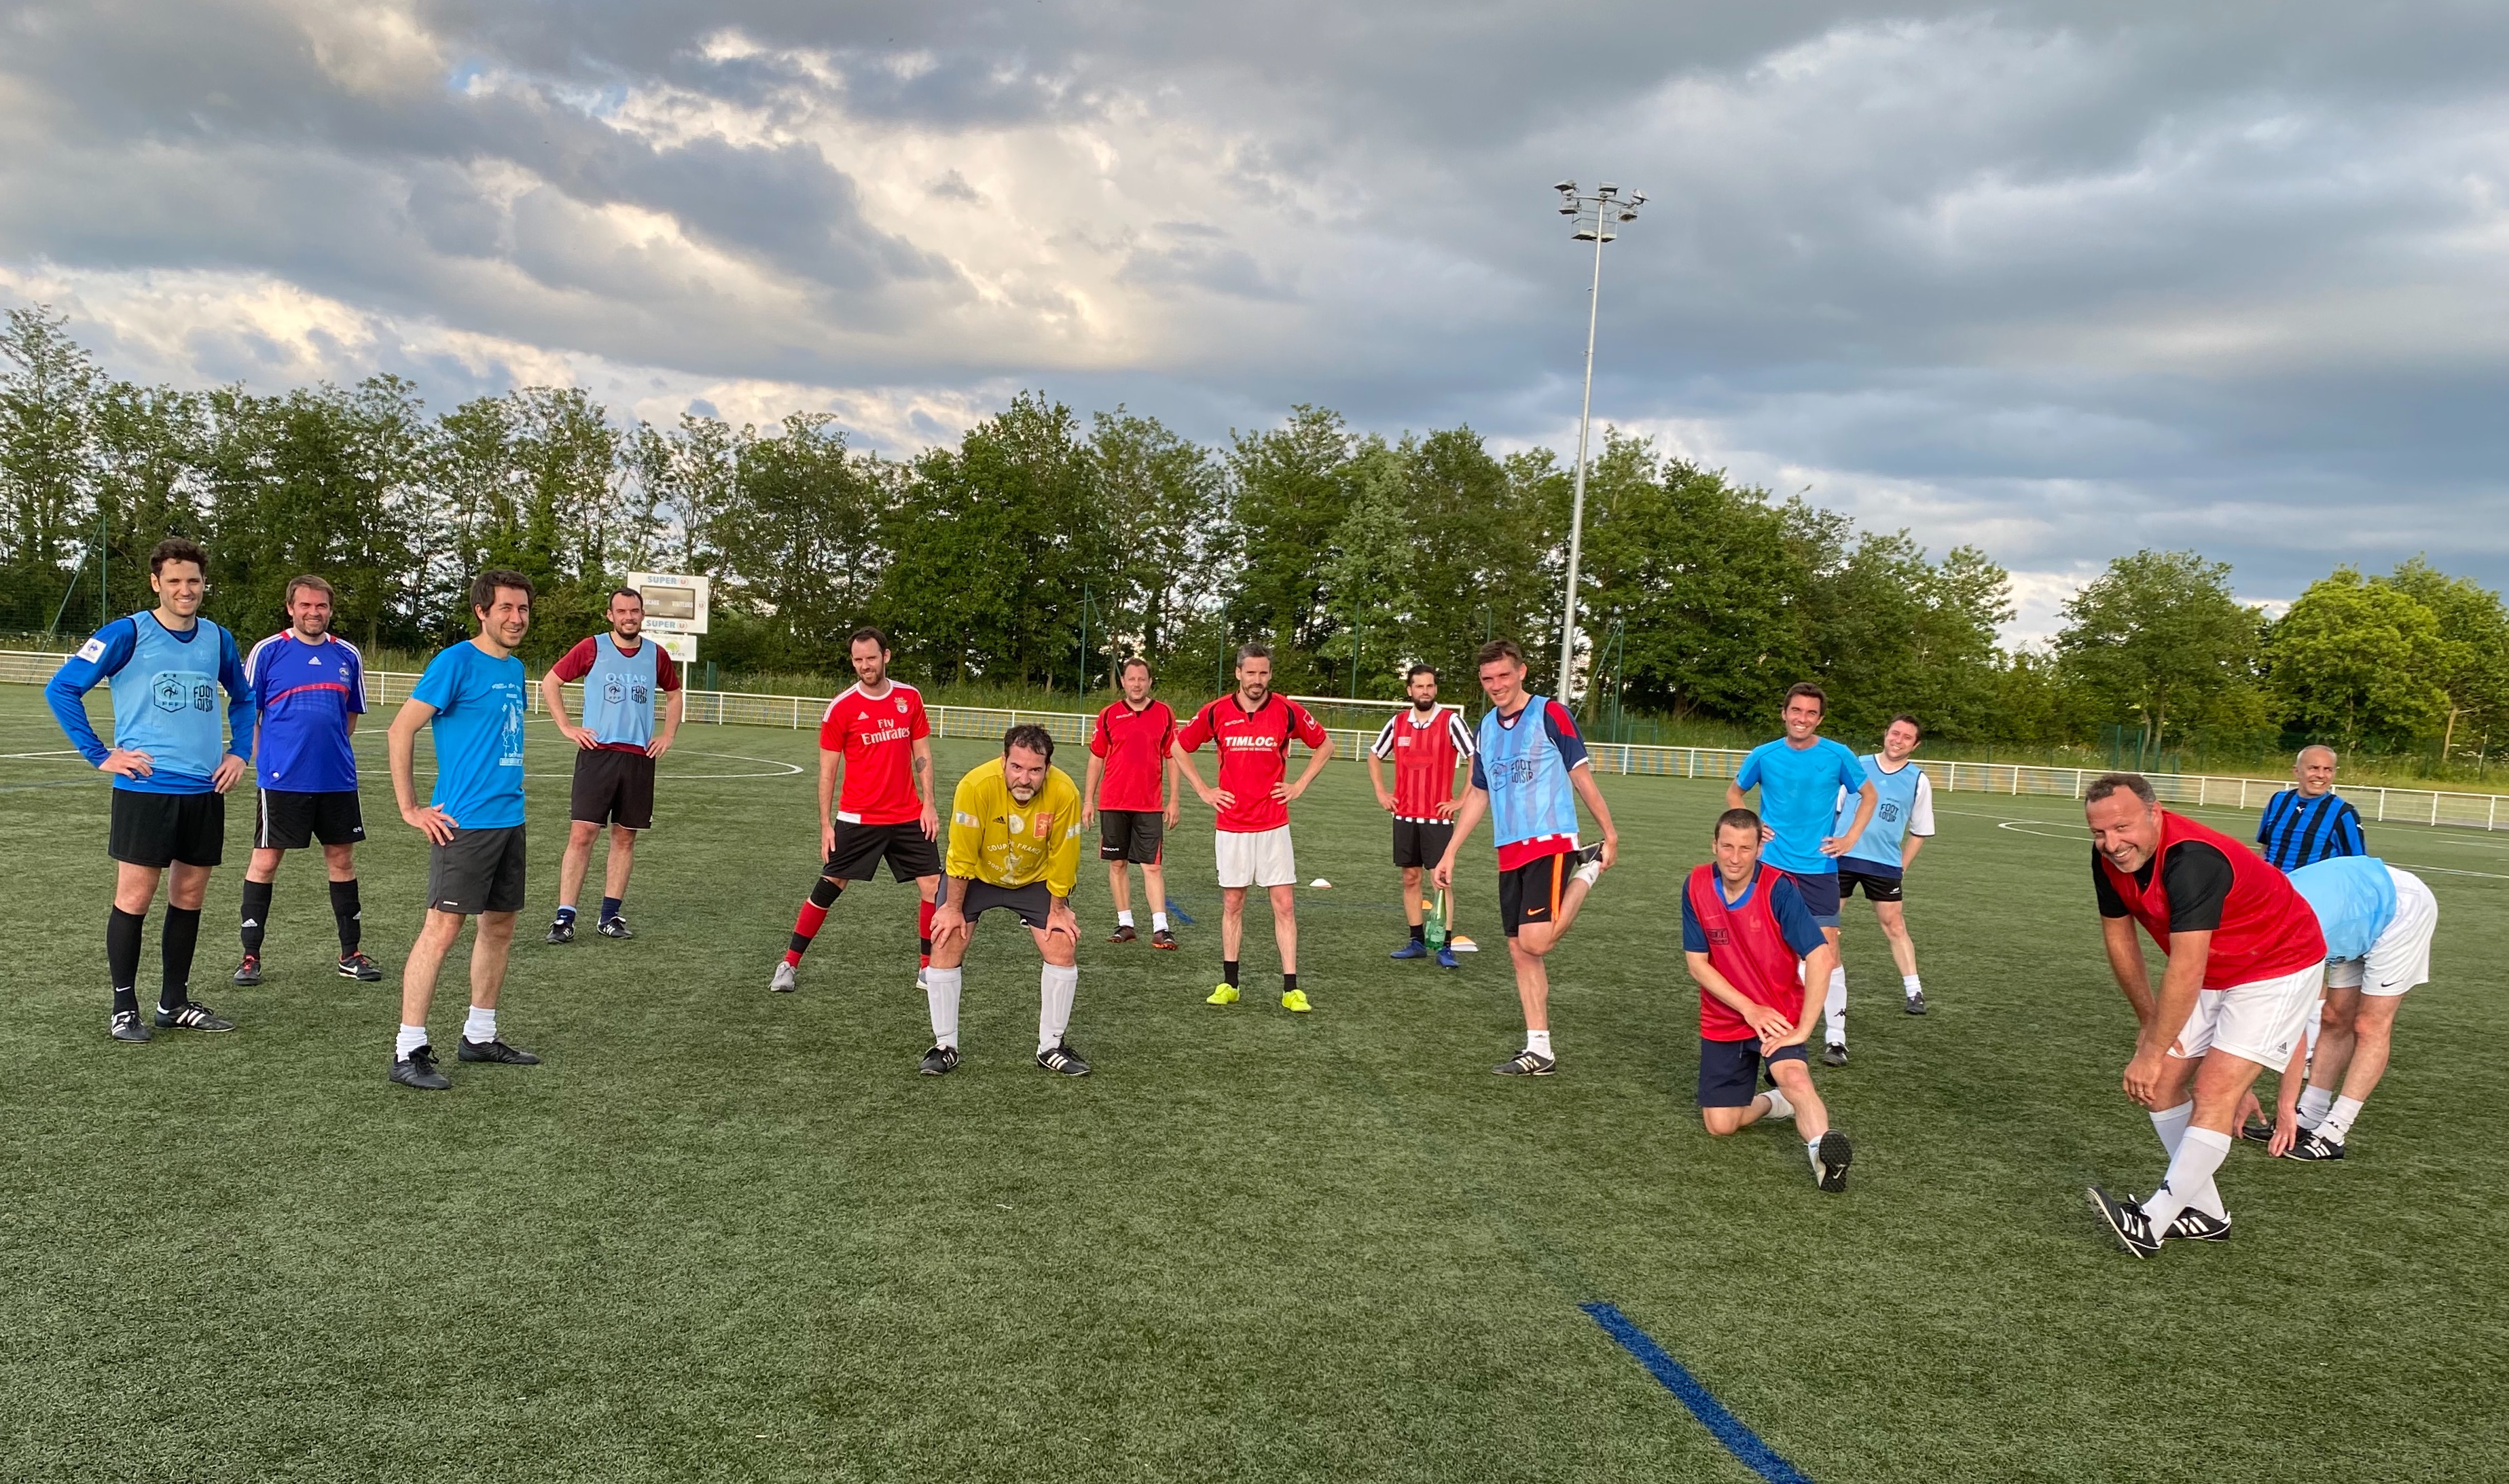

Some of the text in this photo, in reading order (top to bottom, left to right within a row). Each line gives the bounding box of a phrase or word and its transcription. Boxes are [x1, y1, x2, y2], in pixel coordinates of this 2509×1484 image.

[647, 576, 677, 584] SUPER
[646, 620, 676, 628] SUPER
[605, 672, 647, 683] QATAR
[194, 684, 213, 700] FOOT
[631, 685, 648, 696] FOOT
[877, 718, 895, 729] Fly
[861, 726, 910, 746] Emirates
[1225, 736, 1275, 747] TIMLOC
[1511, 759, 1532, 772] FOOT
[1511, 771, 1534, 784] LOISIR
[1880, 803, 1899, 816] FOOT
